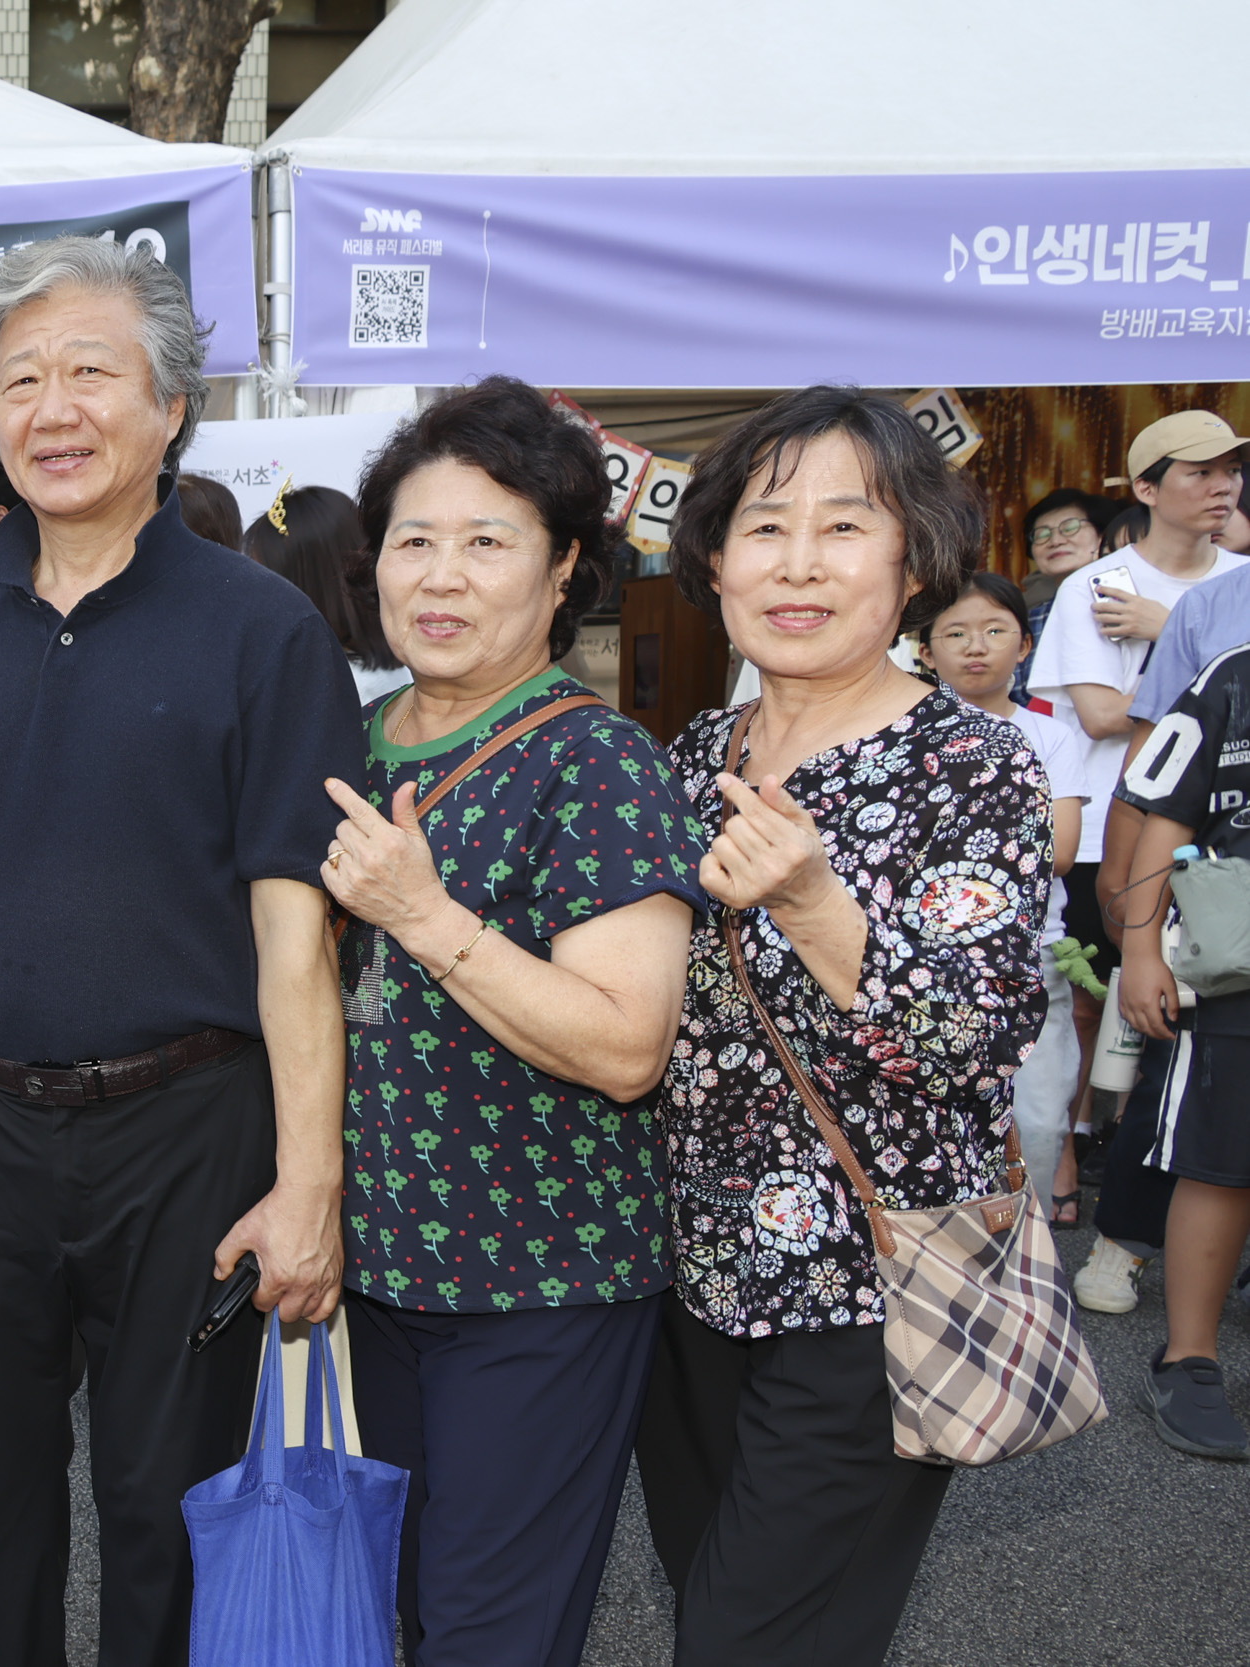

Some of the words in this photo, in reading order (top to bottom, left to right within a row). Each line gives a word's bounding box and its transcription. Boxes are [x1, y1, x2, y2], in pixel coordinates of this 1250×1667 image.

[343, 239, 373, 256] 서리풀
[376, 239, 398, 256] 뮤직
[400, 239, 442, 256] 페스티벌
[973, 221, 1250, 291] 인생네컷_
[1100, 307, 1250, 339] 방배교육지
[232, 466, 271, 486] 서초
